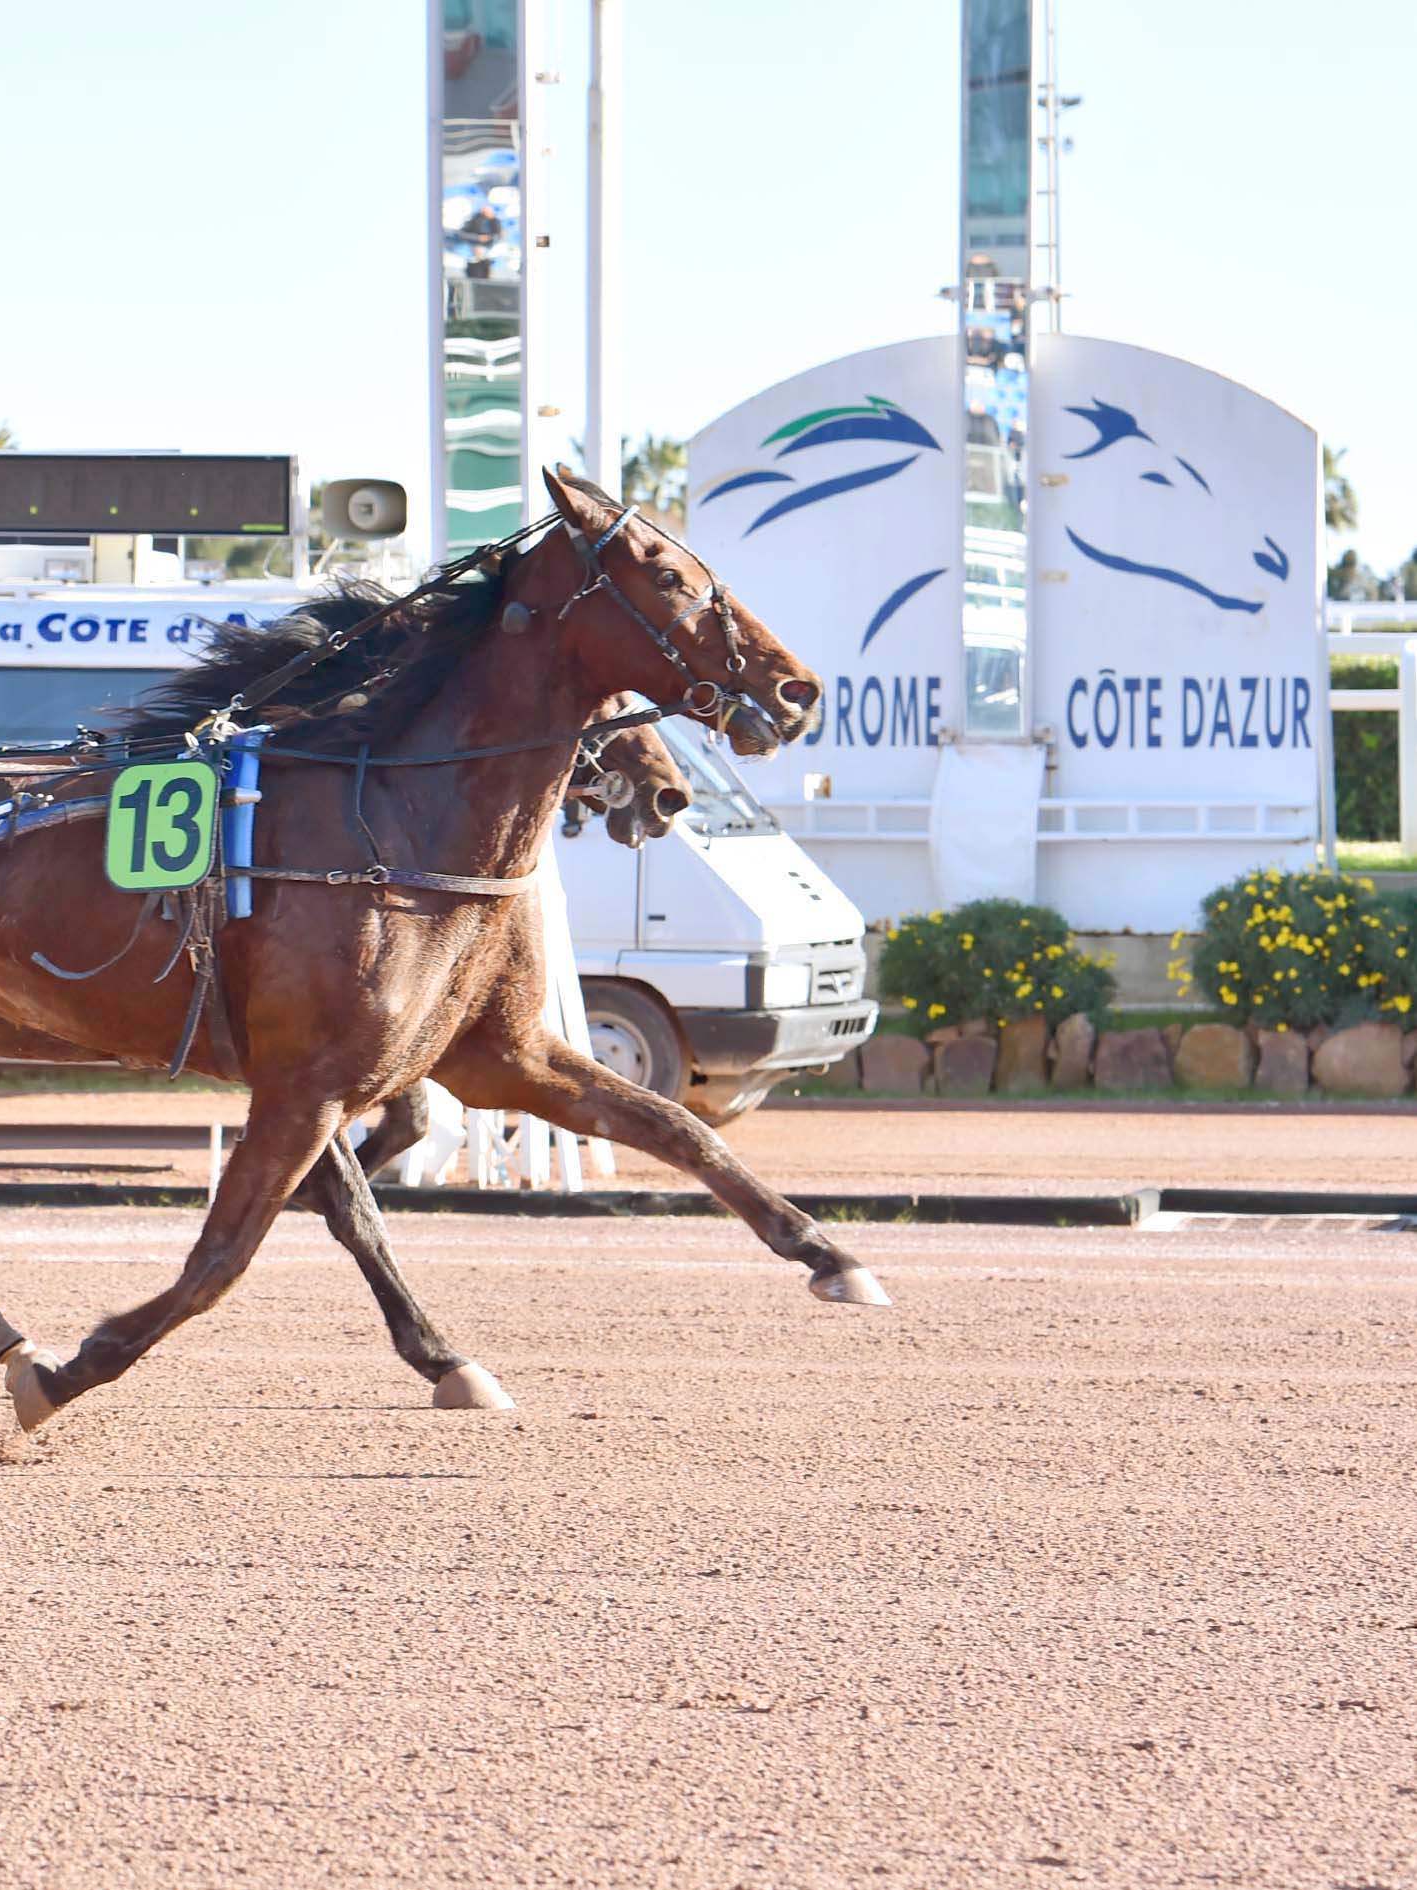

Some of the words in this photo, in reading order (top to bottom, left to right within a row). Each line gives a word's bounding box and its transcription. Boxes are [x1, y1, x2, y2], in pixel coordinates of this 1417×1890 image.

[1067, 668, 1162, 749] CÔTE
[1183, 676, 1312, 749] D'AZUR
[119, 776, 203, 873] 13
